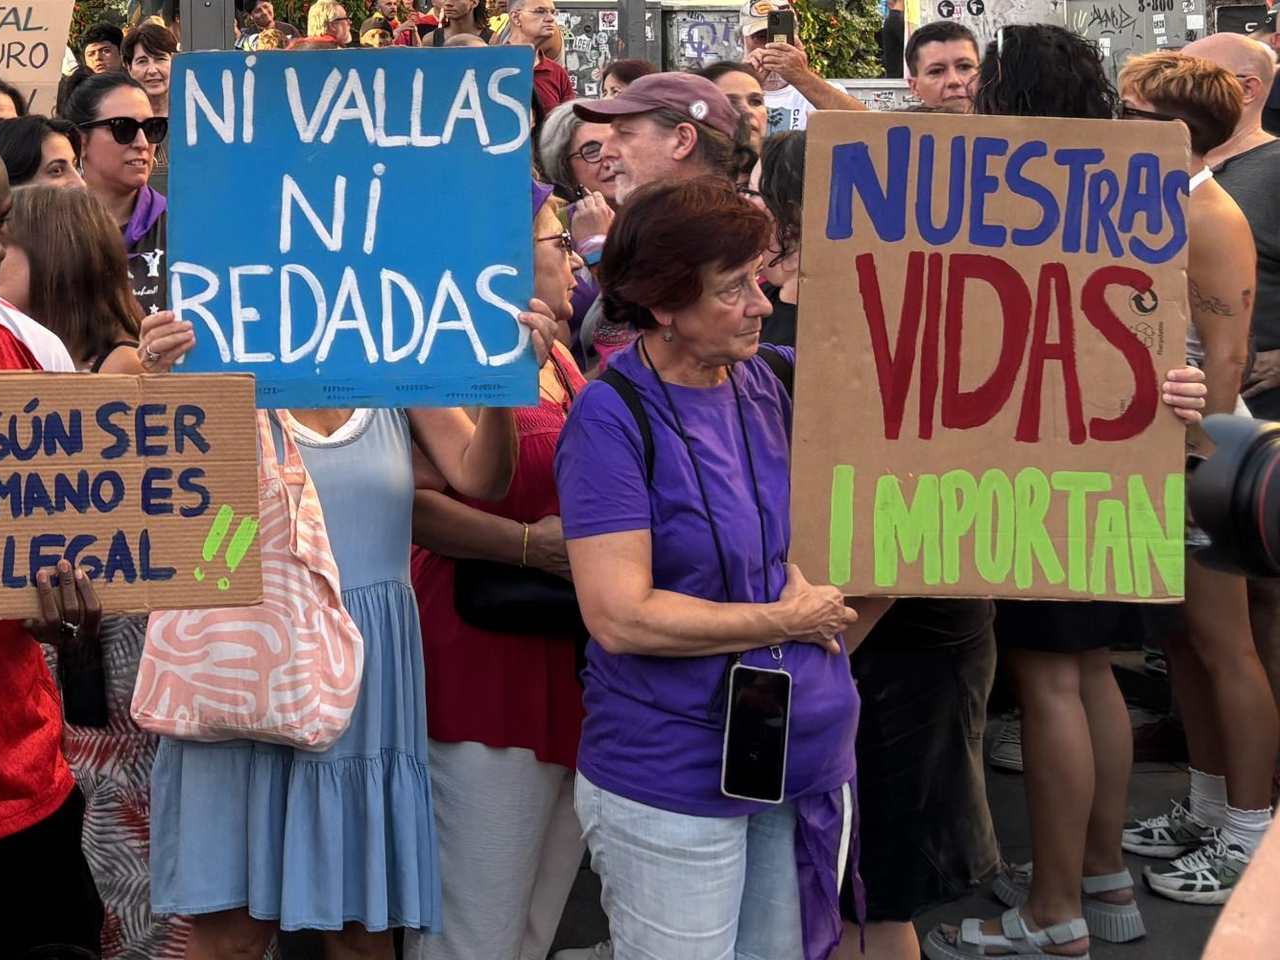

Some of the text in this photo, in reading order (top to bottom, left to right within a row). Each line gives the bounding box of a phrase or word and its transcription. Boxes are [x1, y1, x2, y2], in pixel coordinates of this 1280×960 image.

[284, 67, 531, 155] VALLAS
[825, 126, 1190, 263] NUESTRAS
[169, 263, 532, 366] REDADAS
[855, 251, 1158, 445] VIDAS
[95, 400, 210, 459] SER
[141, 467, 210, 517] ES
